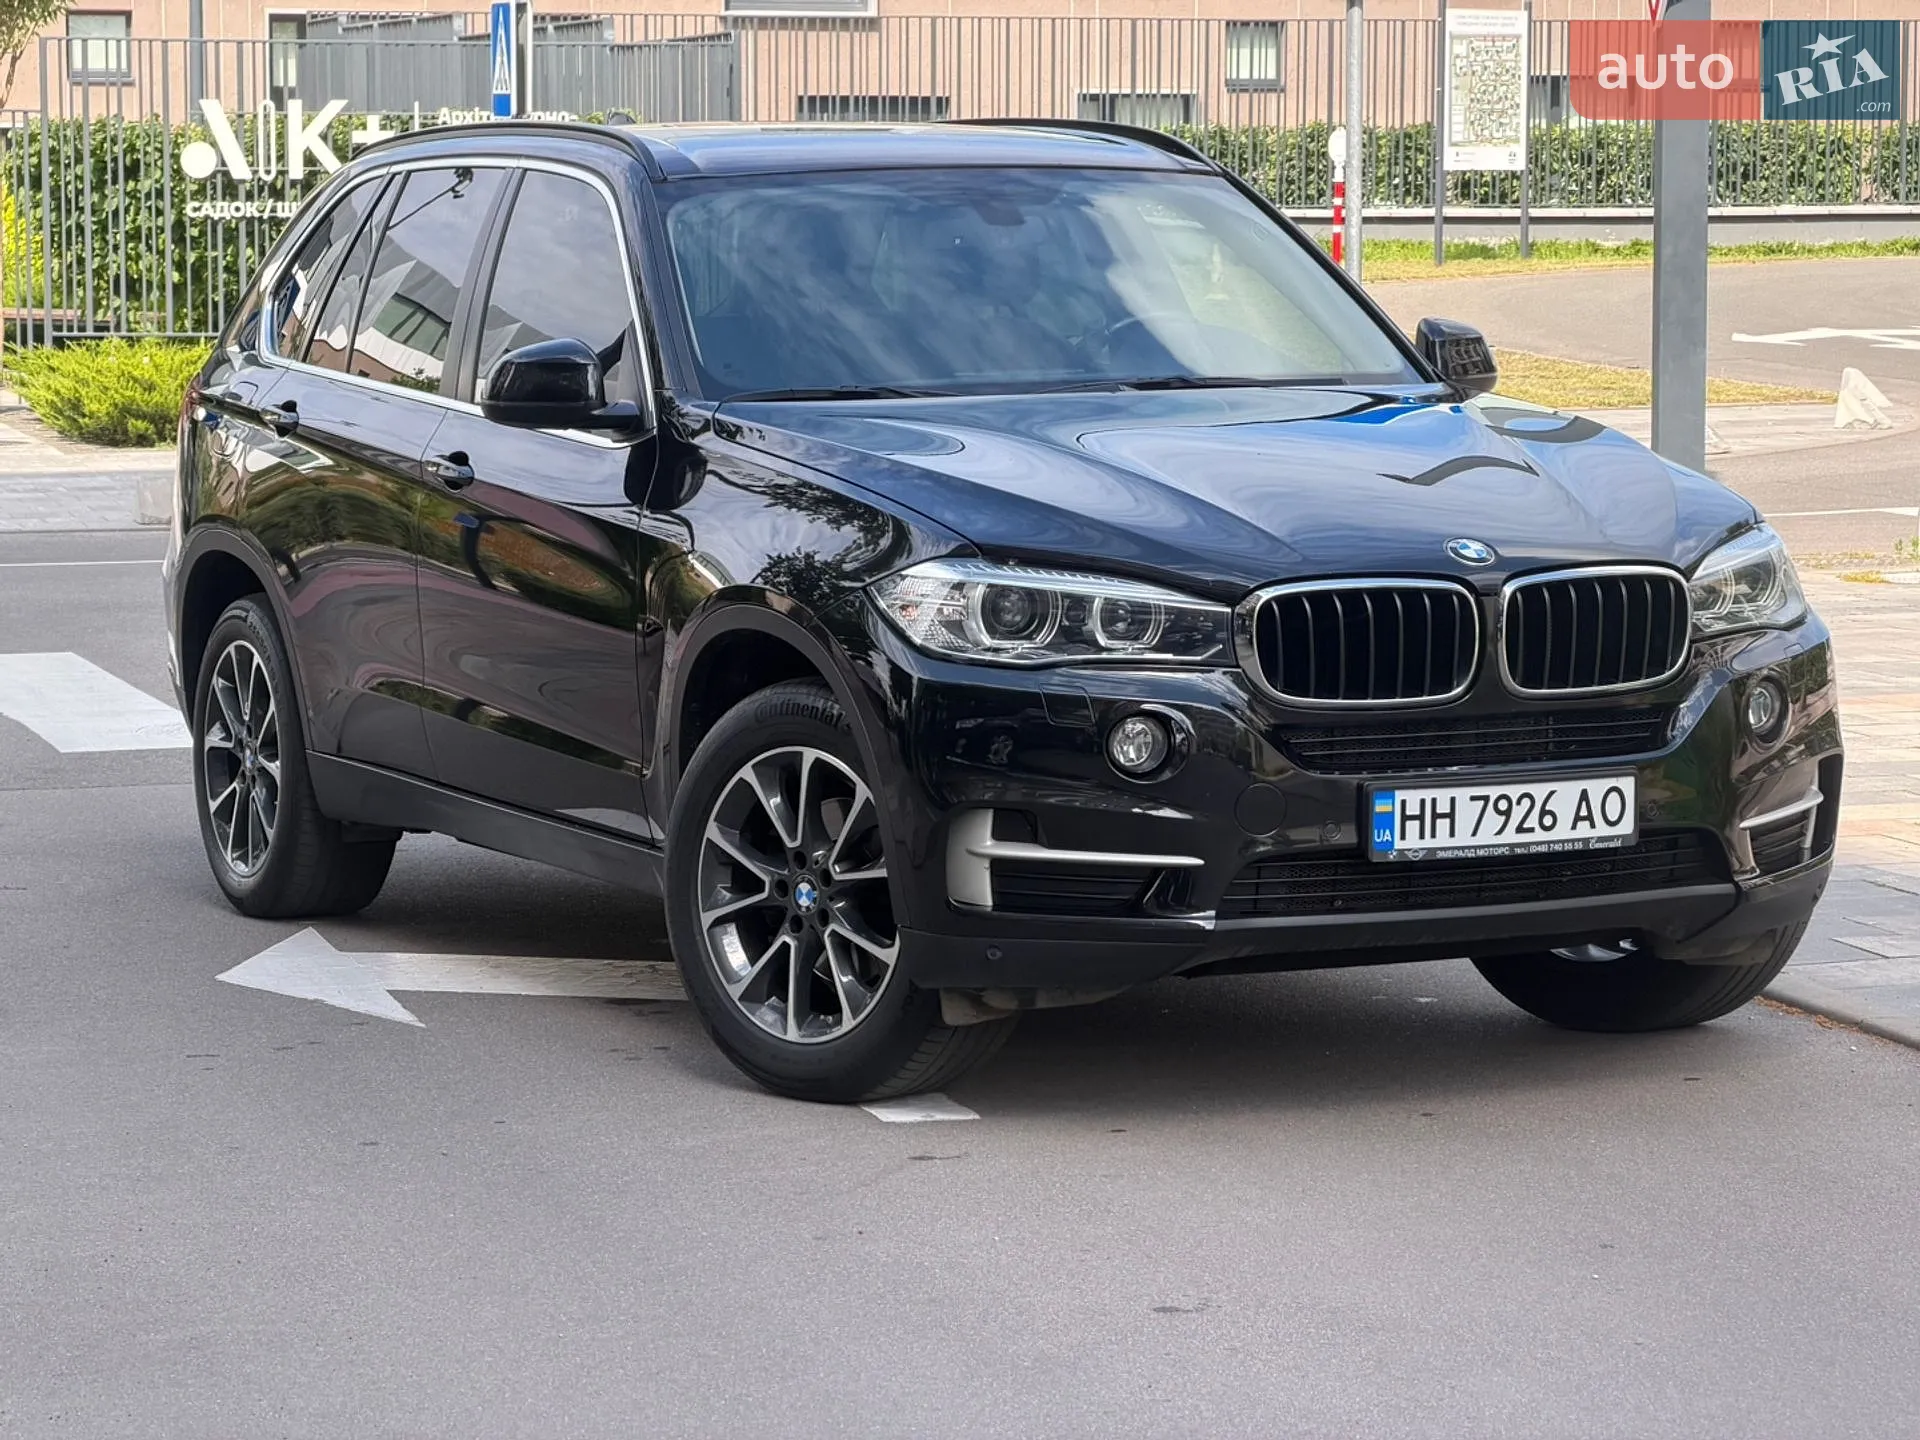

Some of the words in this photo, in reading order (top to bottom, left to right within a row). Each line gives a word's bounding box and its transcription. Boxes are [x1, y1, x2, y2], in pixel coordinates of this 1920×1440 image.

[1399, 796, 1457, 842] HH
[1469, 789, 1559, 838] 7926
[1570, 785, 1627, 831] AO
[1374, 829, 1393, 843] UA
[1549, 843, 1563, 852] 740
